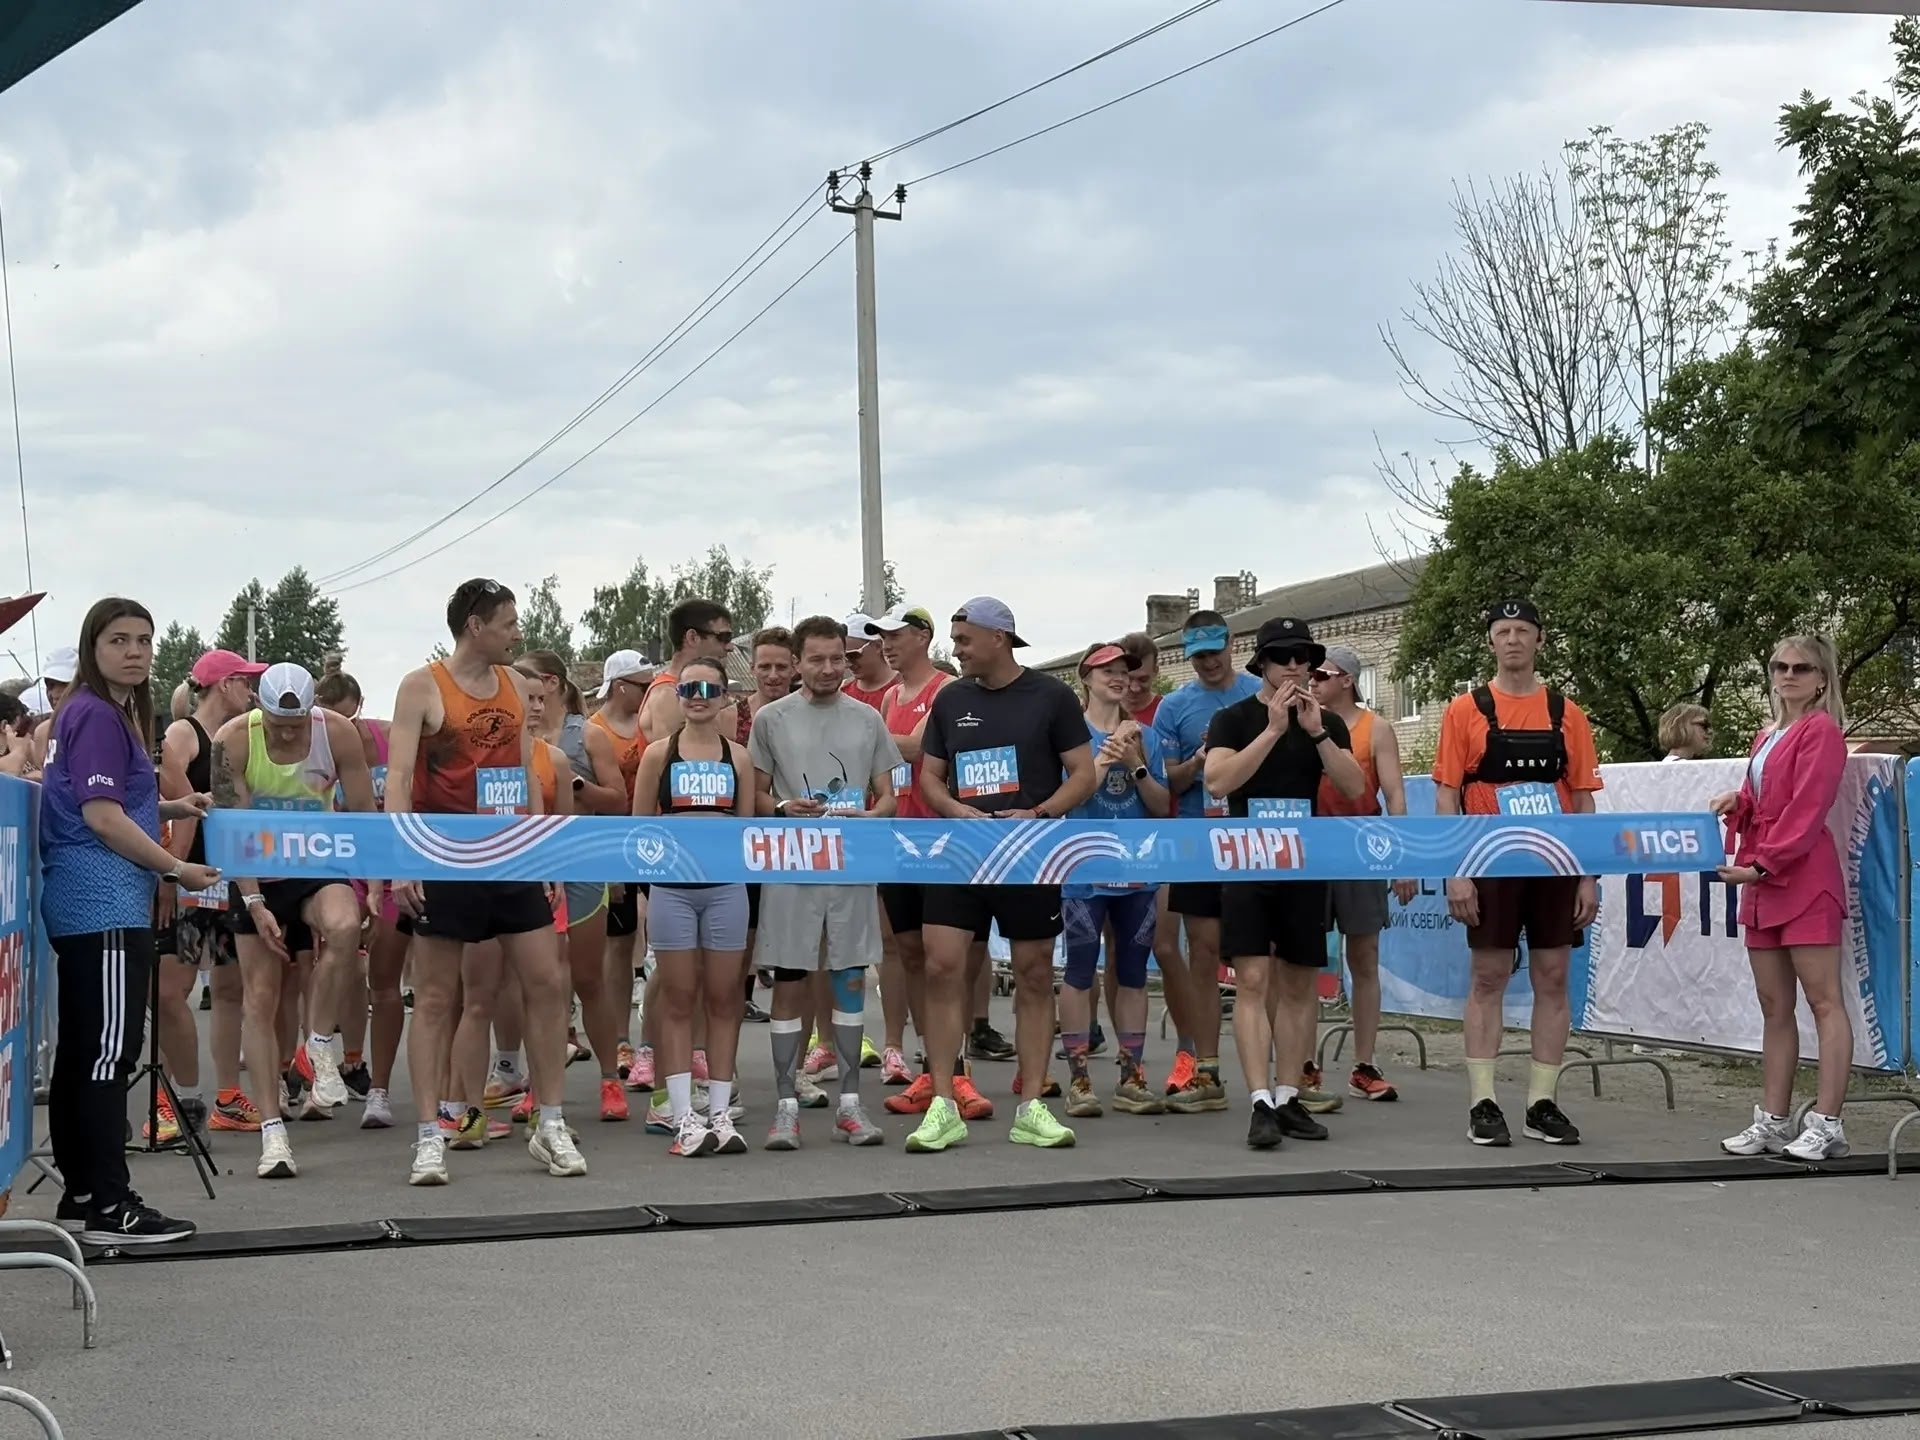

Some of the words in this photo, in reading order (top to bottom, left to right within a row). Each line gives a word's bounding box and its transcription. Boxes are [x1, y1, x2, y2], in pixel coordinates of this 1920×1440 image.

[96, 773, 114, 787] ПСБ
[678, 773, 727, 795] 02106
[964, 759, 1010, 785] 02134
[484, 781, 521, 805] 02127
[1508, 794, 1554, 816] 02121
[282, 833, 357, 858] ПСБ
[743, 827, 843, 871] СТАРТ
[1209, 827, 1301, 871] СТАРТ
[1640, 829, 1699, 854] ПСБ
